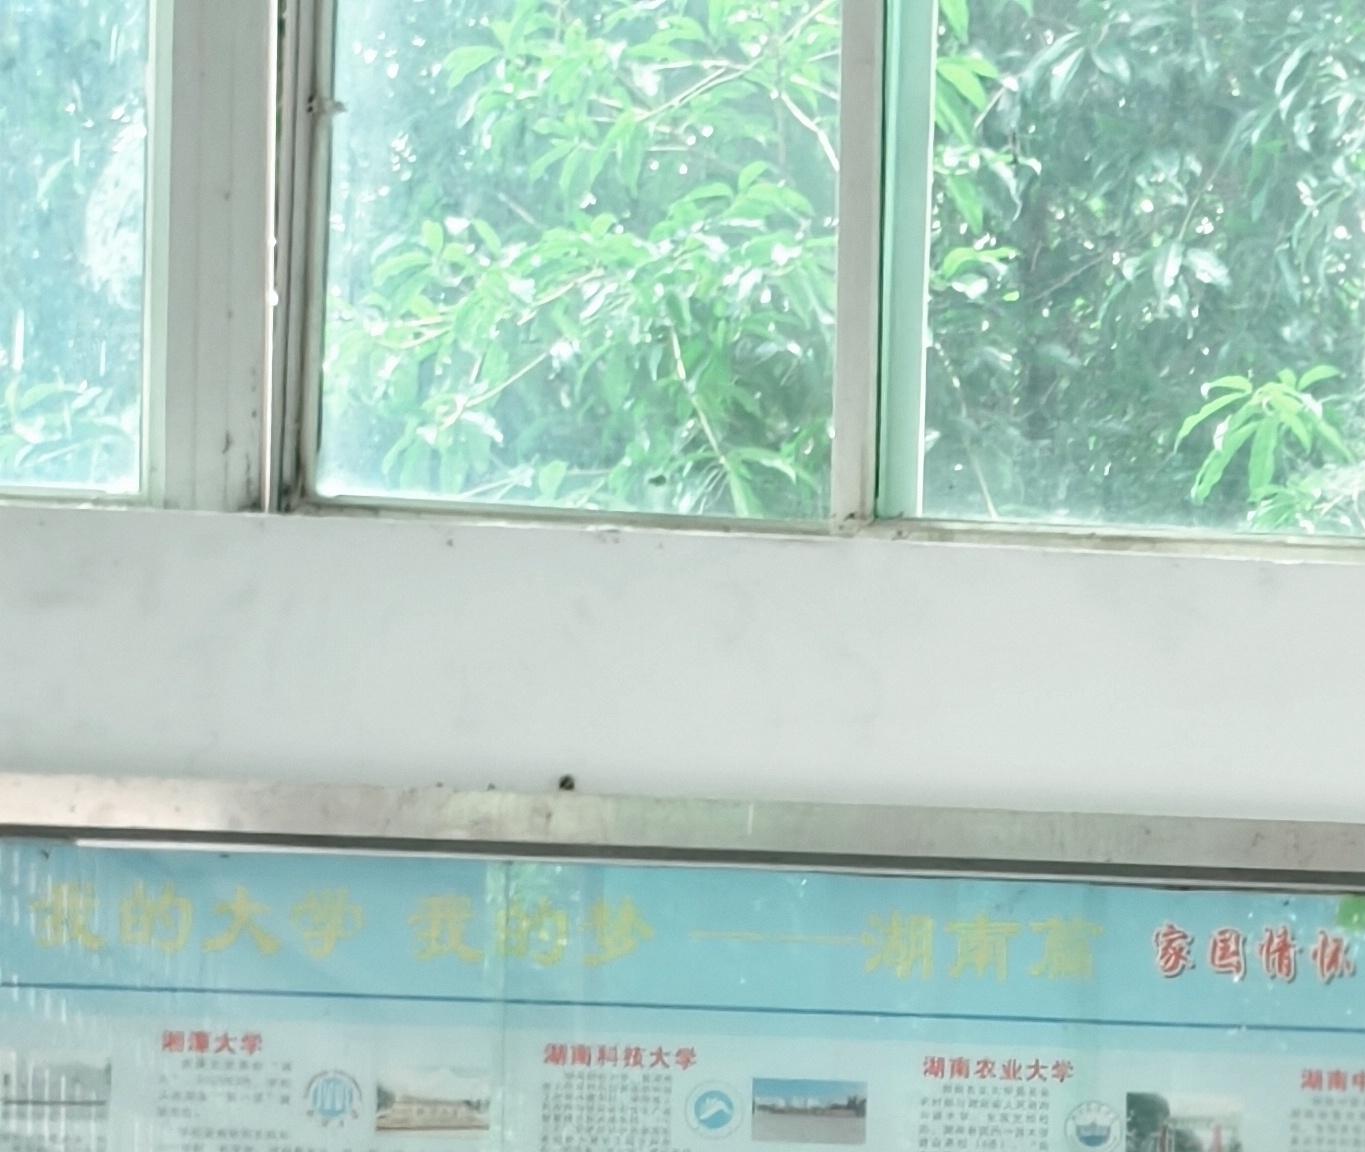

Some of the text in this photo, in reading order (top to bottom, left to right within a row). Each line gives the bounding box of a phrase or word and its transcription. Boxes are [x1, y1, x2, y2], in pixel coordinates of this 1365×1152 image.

[31, 880, 366, 957] 我的大学
[407, 892, 656, 969] 我的梦
[1152, 923, 1357, 985] 家国情怀
[161, 1029, 263, 1056] 湘潭大学
[543, 1043, 697, 1070] 湖南科技大学
[921, 1056, 1075, 1083] 湖南农业大学
